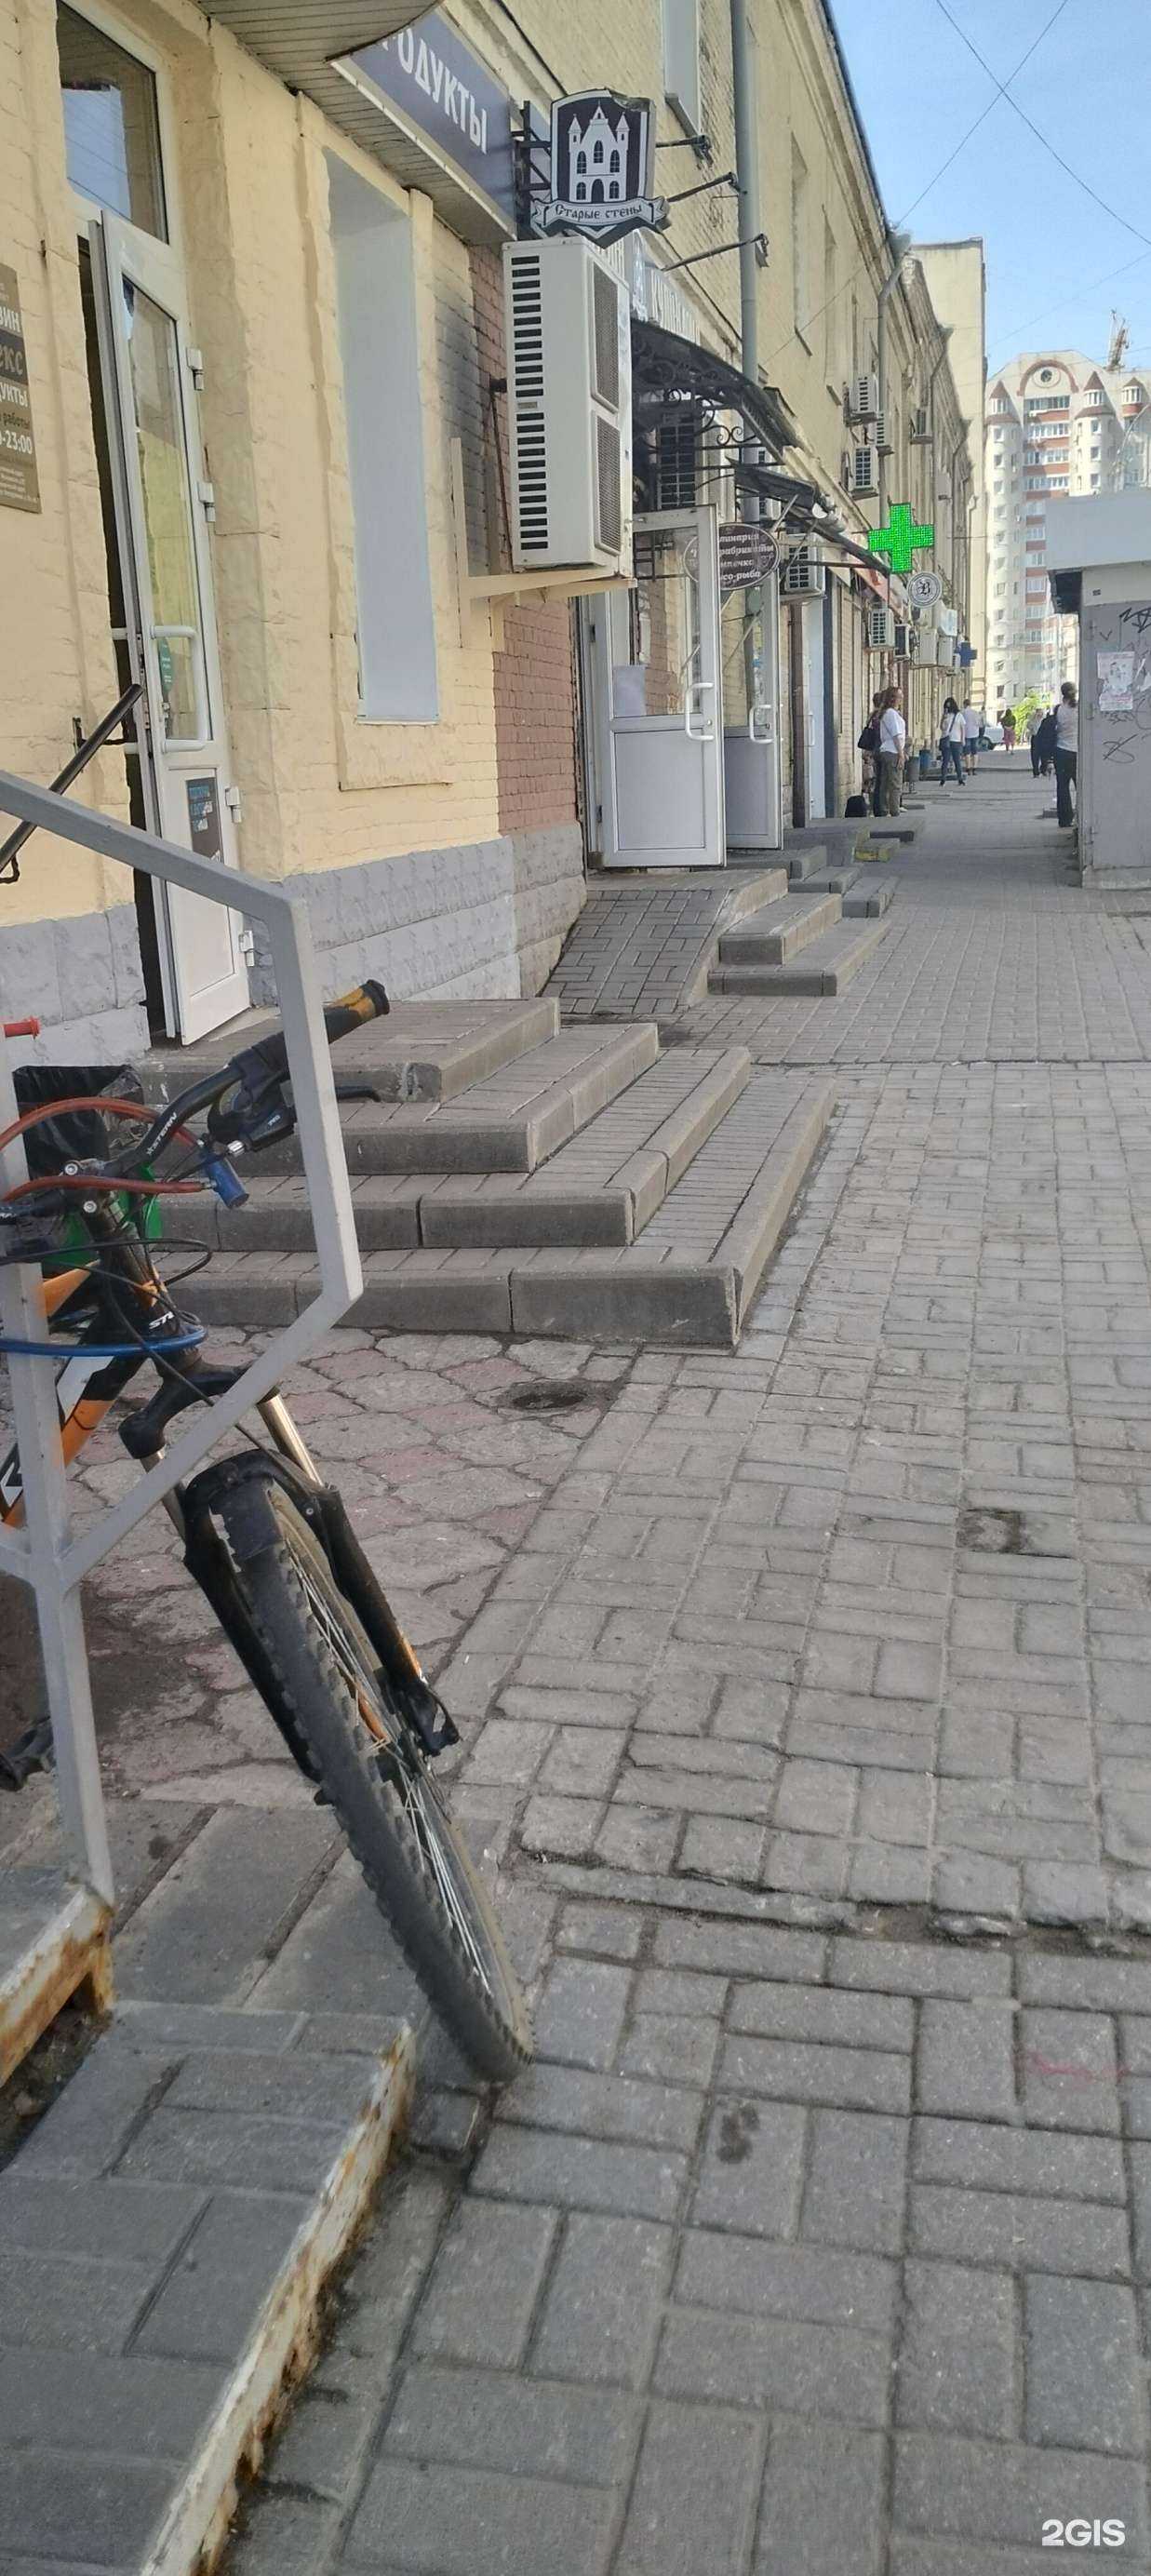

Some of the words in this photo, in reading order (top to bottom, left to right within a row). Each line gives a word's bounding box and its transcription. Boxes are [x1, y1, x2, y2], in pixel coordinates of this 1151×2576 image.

[382, 28, 487, 154] ОДУКТЫ
[555, 204, 600, 221] Старые
[605, 203, 642, 219] стены
[0, 382, 28, 408] УКТЫ
